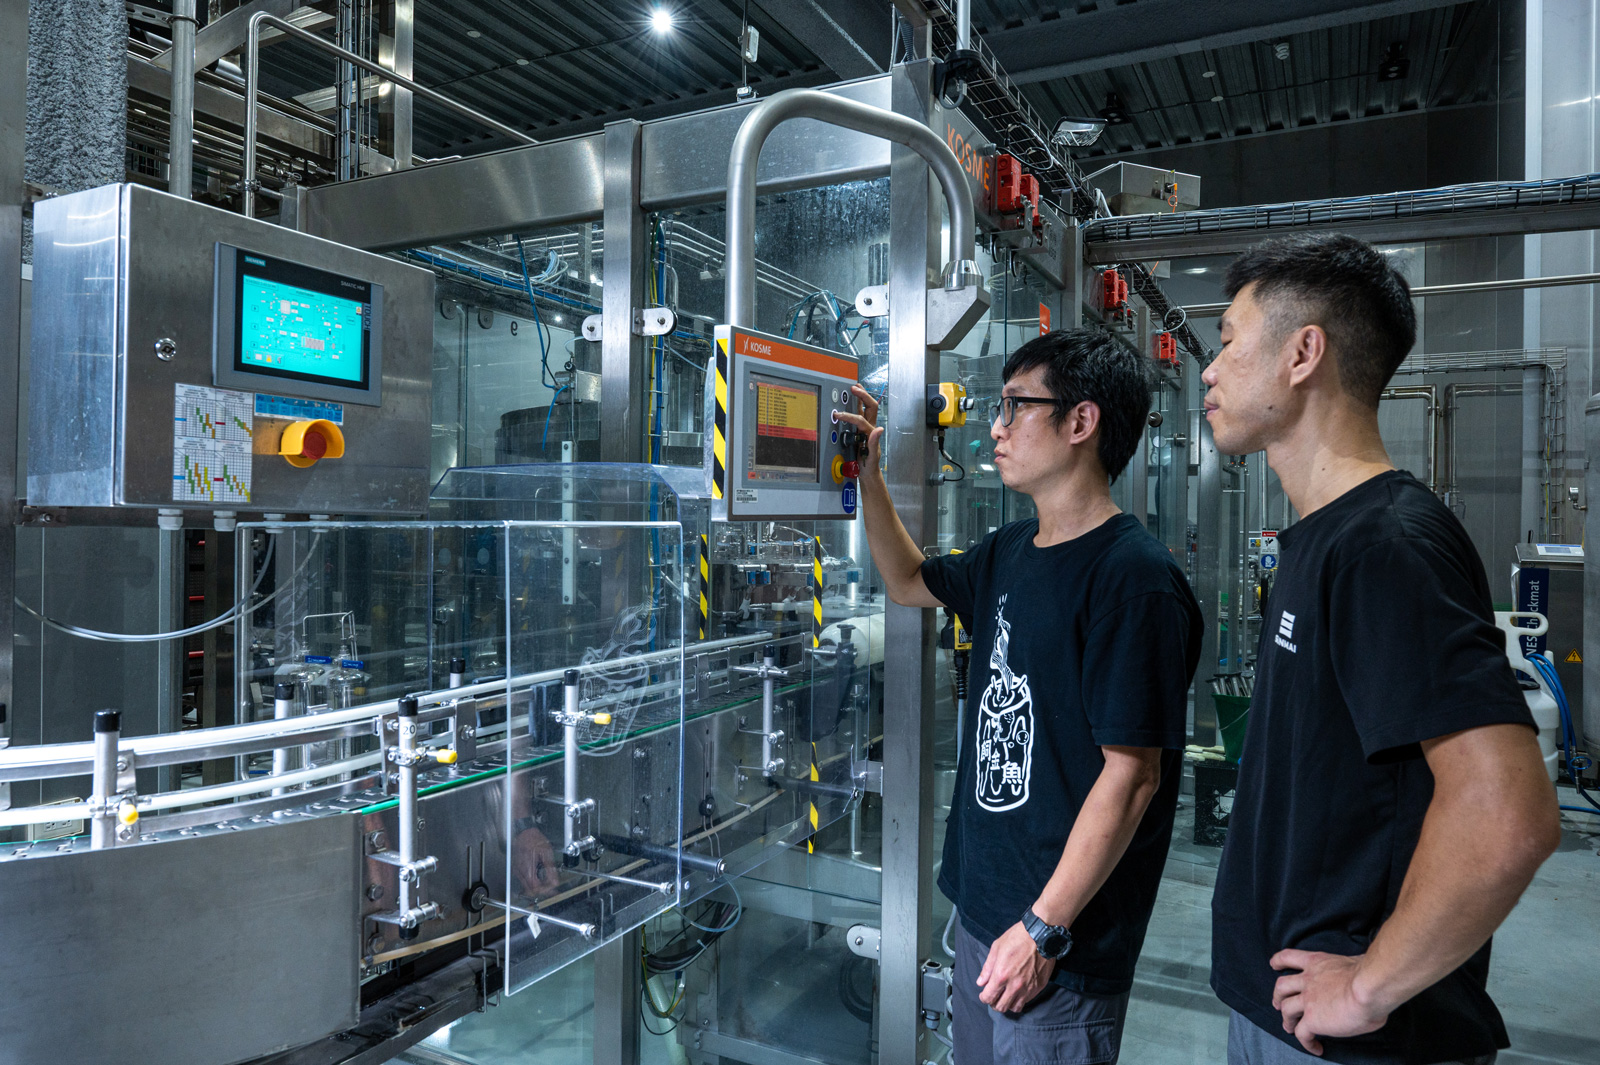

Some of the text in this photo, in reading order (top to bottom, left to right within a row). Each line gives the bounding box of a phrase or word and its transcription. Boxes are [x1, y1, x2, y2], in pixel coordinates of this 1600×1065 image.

[947, 123, 990, 191] KOSME
[750, 341, 772, 356] KOSME
[402, 724, 416, 736] 20
